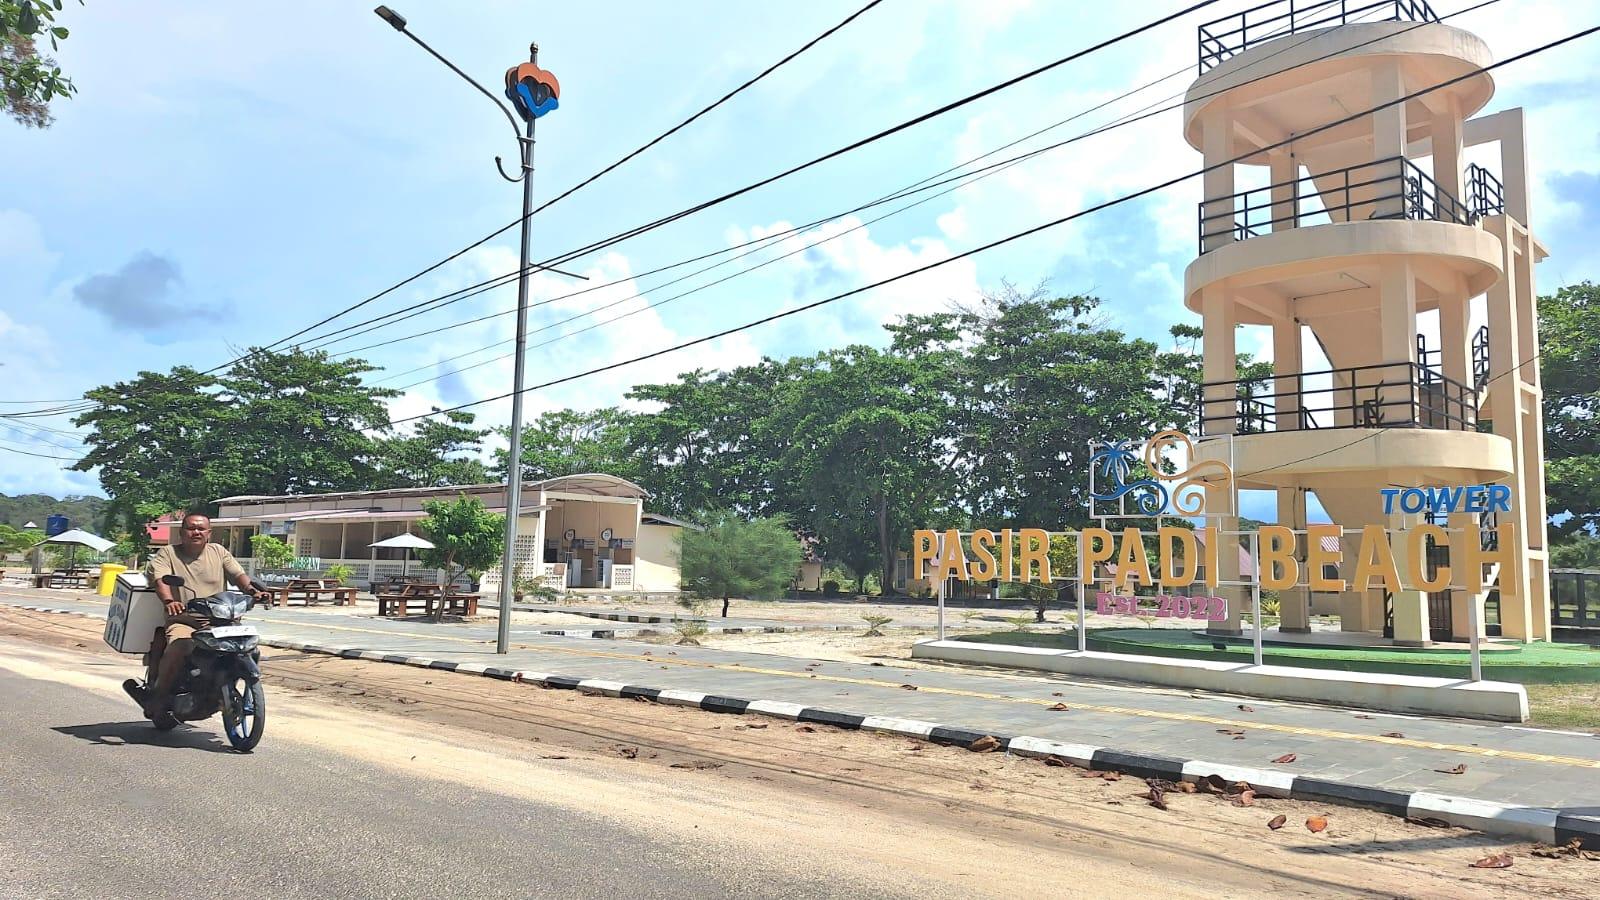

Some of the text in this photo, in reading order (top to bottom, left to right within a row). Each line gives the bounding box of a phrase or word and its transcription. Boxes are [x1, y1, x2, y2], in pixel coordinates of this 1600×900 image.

[1380, 484, 1513, 515] TOWER
[913, 522, 1518, 596] PASIR PADI BEACH
[1095, 592, 1229, 622] Est. 2022
